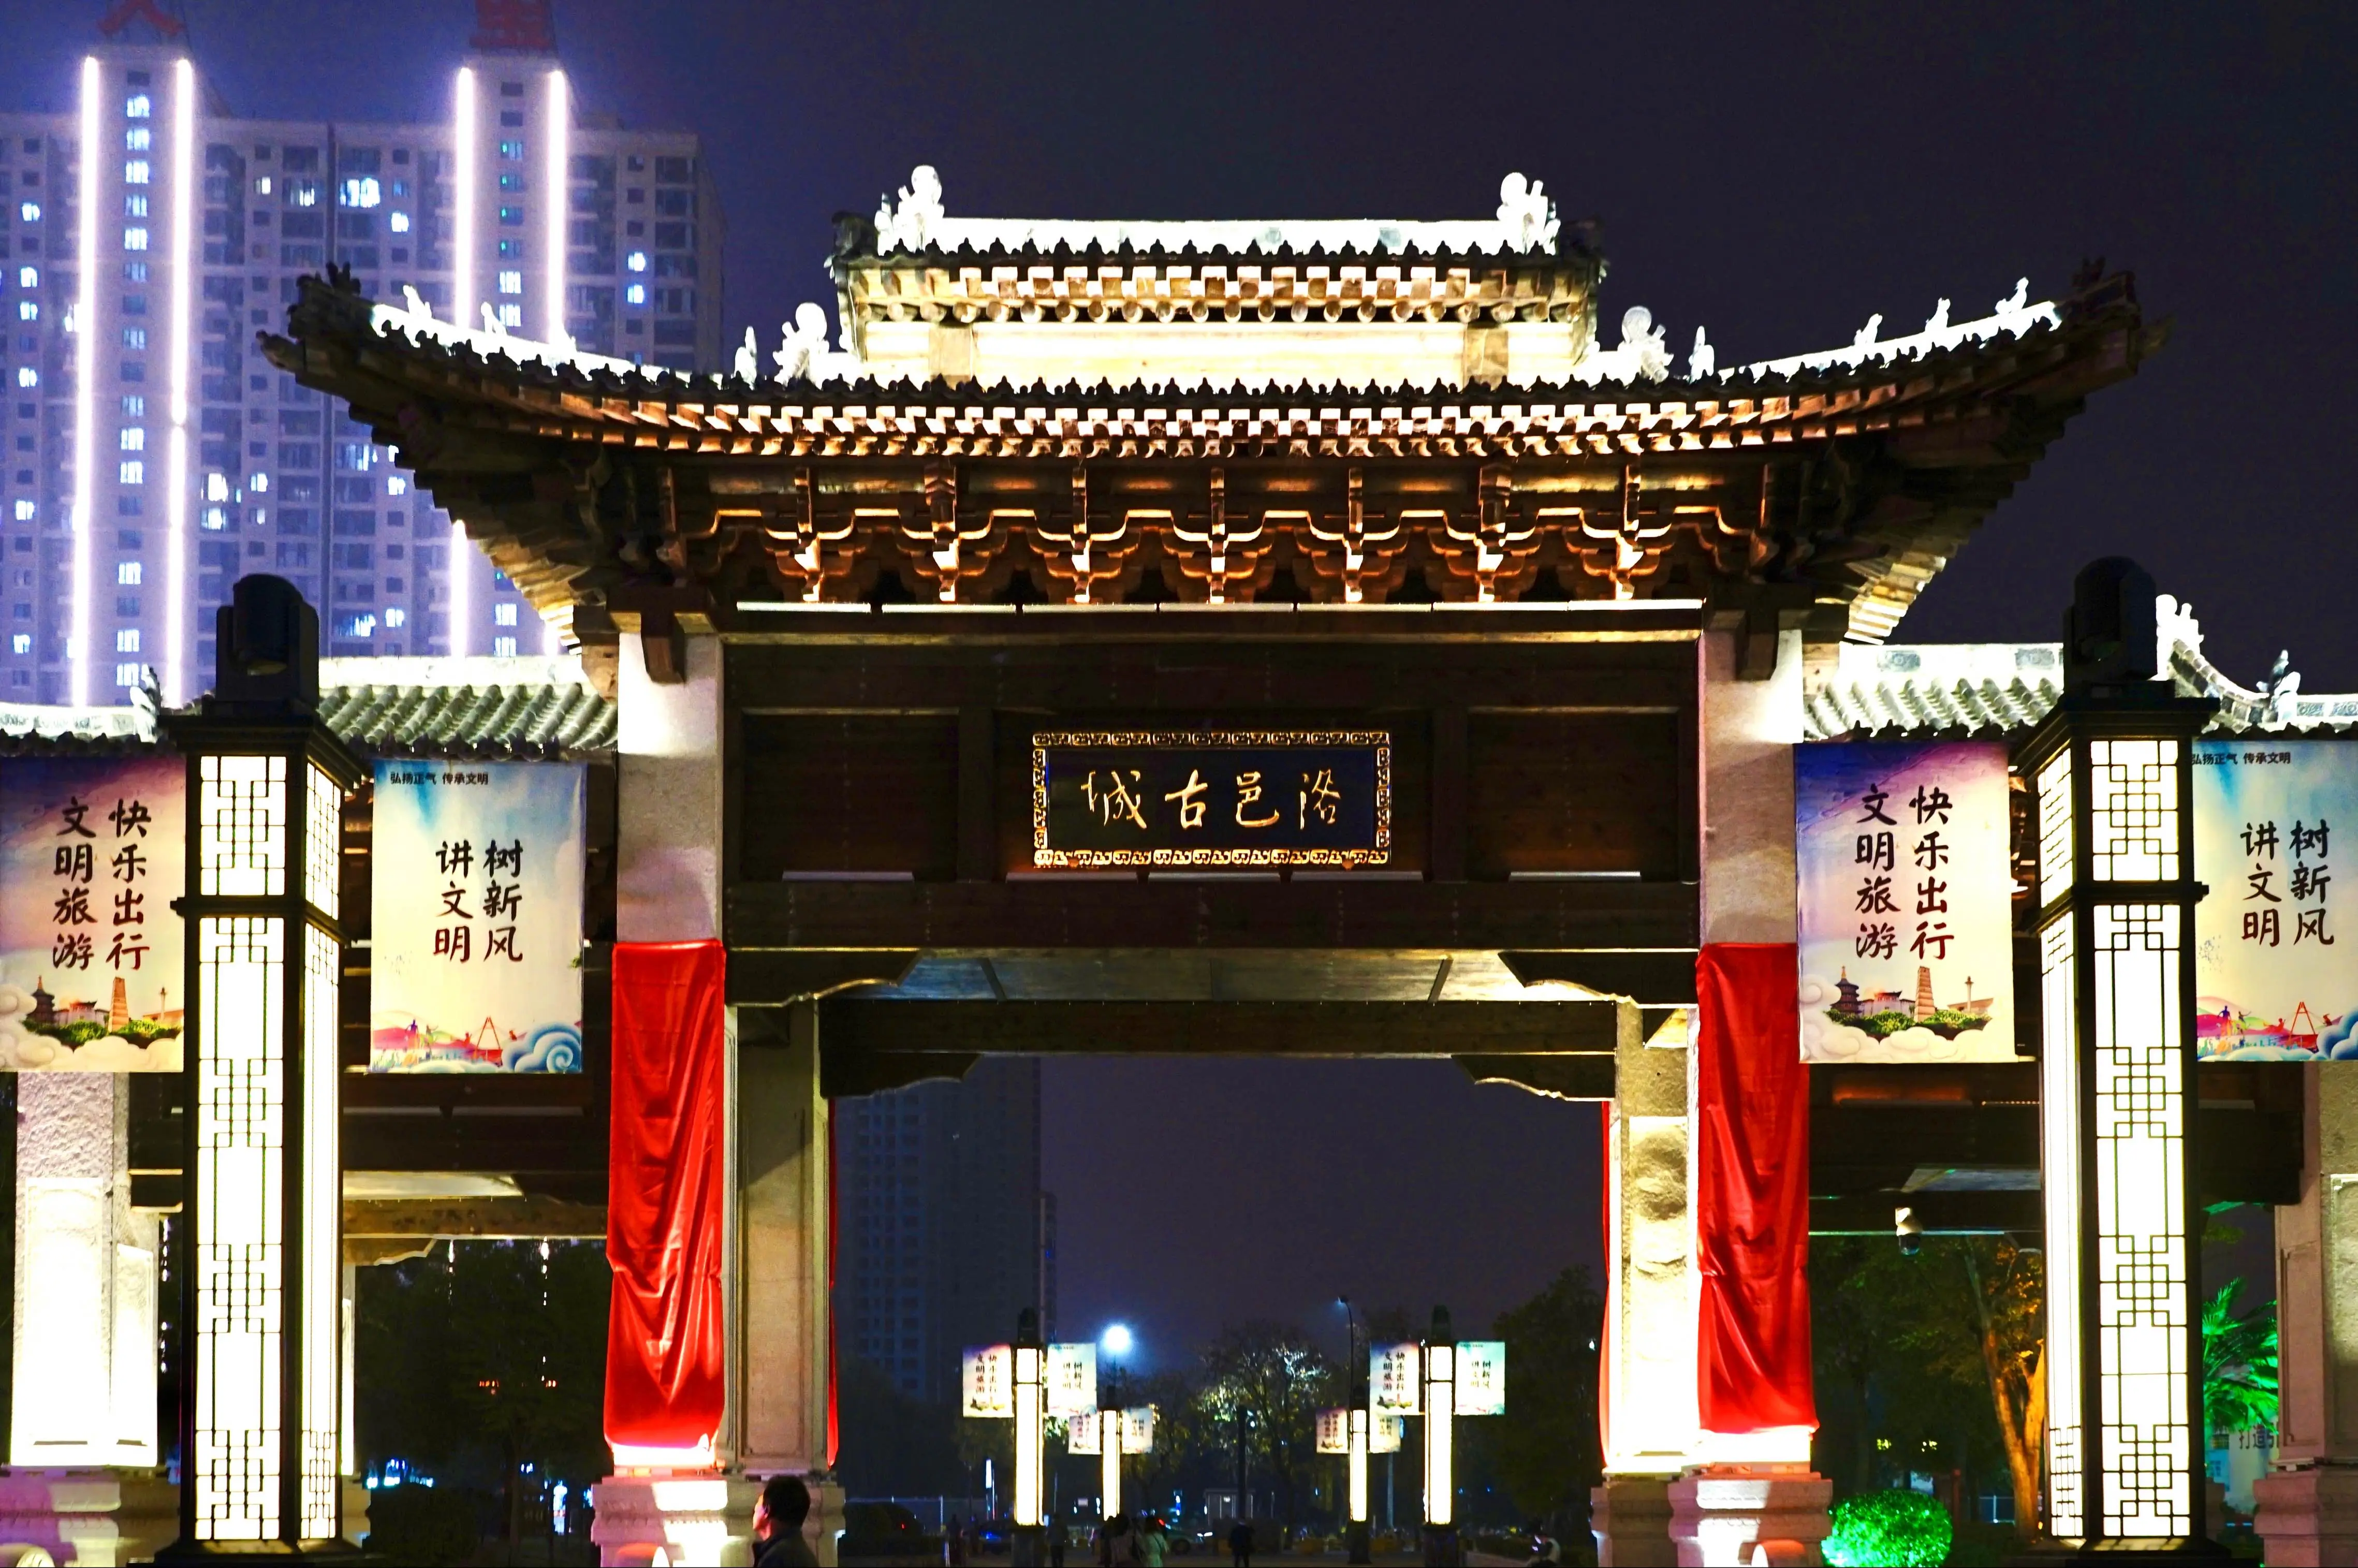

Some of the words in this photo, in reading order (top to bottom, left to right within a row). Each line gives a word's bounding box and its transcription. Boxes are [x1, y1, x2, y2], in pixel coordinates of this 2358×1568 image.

[390, 771, 437, 785] 弘扬正气
[442, 771, 489, 785] 传承文明
[2243, 752, 2291, 765] 传承文明
[52, 796, 97, 971] 文明旅游
[106, 798, 151, 971] 快乐出行
[433, 839, 474, 962] 讲文明
[483, 839, 523, 962] 树新风
[1855, 783, 1901, 960] 文明旅游
[1909, 785, 1955, 960] 快乐出行
[2240, 820, 2282, 947] 讲文明
[2289, 819, 2334, 945] 树新风
